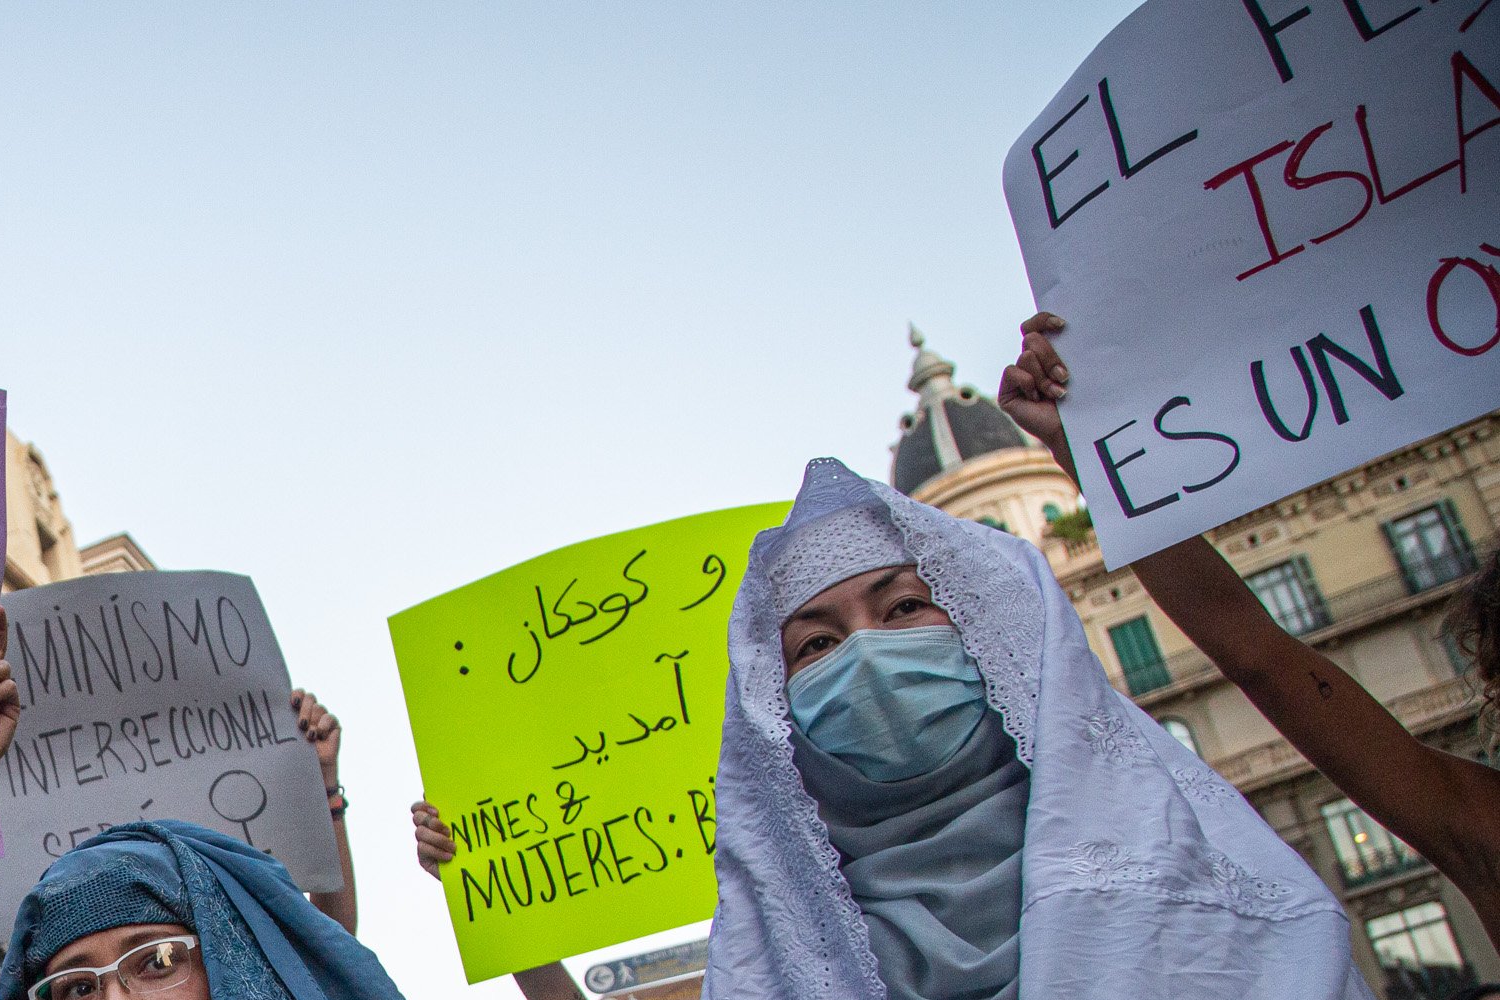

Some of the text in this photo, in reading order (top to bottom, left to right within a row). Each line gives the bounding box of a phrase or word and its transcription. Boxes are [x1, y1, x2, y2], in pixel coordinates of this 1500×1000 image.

[1031, 78, 1198, 229] EL
[1094, 396, 1241, 519] ES
[1250, 304, 1404, 443] UN
[3, 689, 298, 798] INTERSECCIONAL
